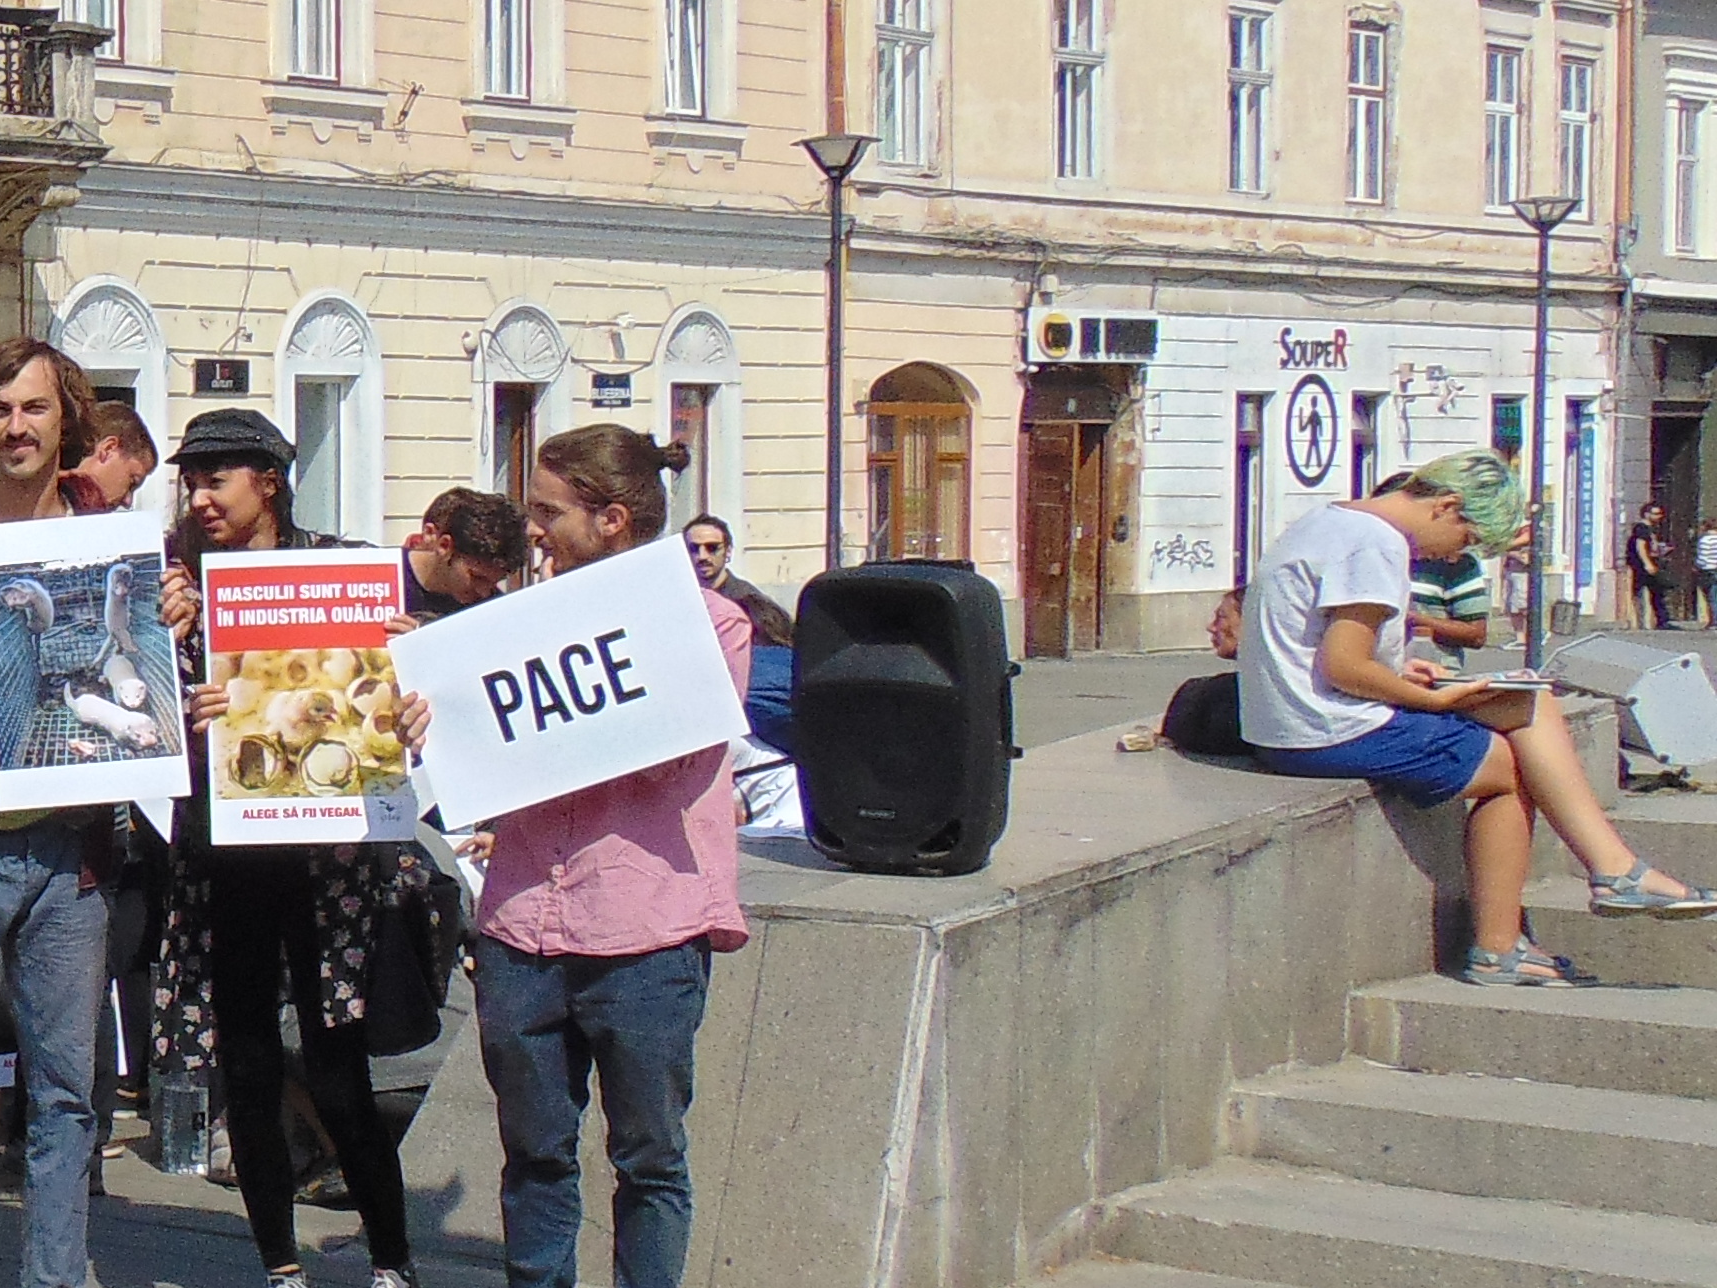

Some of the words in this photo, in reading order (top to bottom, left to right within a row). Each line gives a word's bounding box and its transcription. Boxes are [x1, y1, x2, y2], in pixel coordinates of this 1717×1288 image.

[216, 585, 295, 602] MASCULII
[299, 583, 343, 600] SUNT
[347, 582, 390, 604] UCIȘI
[215, 607, 235, 628] ÎN
[238, 607, 328, 626] INDUSTRIA
[481, 627, 647, 744] PACE
[242, 808, 279, 819] ALEGE
